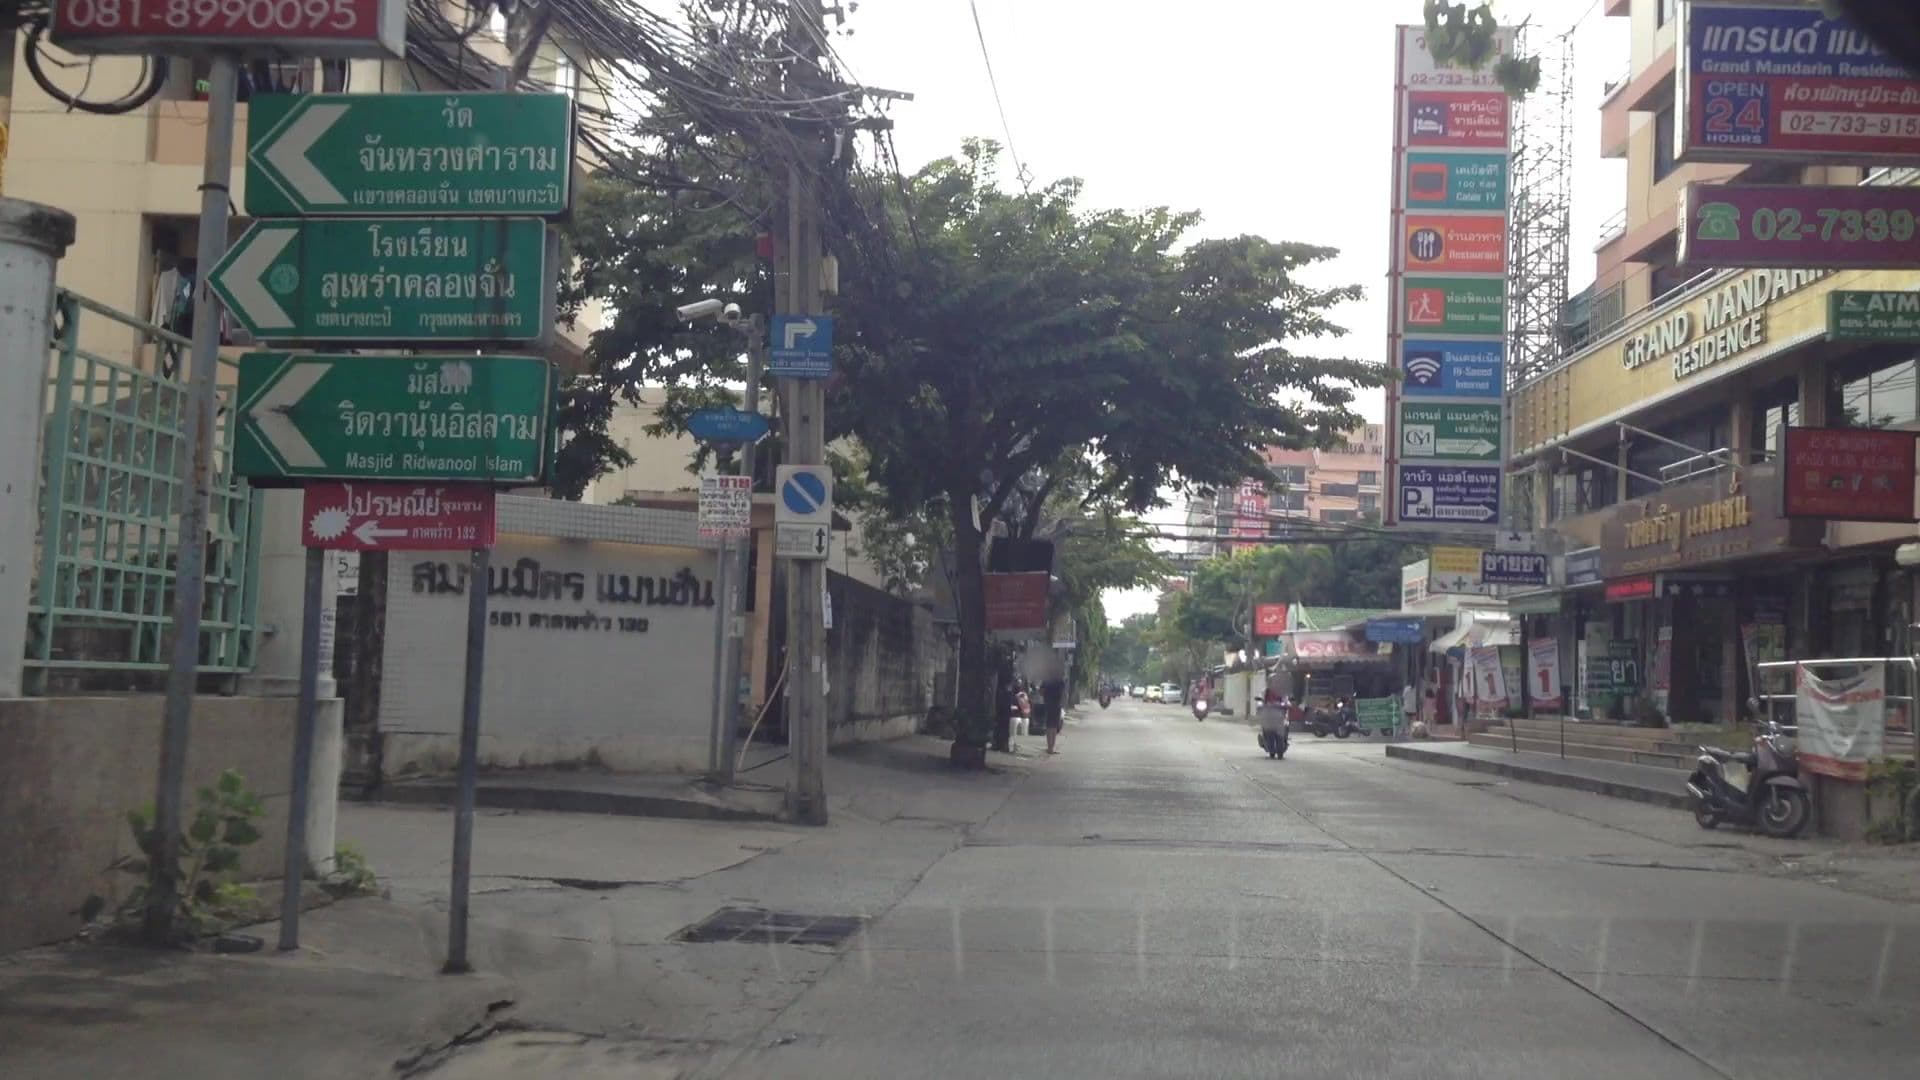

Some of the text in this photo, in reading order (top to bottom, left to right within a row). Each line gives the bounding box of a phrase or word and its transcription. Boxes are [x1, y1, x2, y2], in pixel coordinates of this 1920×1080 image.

[67, 0, 357, 28] 081-8990095
[1703, 20, 1886, 56] แกรนด์ แม
[1702, 58, 1750, 74] Grand
[1755, 60, 1833, 76] Mandarin
[1707, 80, 1764, 98] OPEN
[441, 98, 473, 128] วัด
[1705, 97, 1765, 133] 24
[1790, 115, 1920, 135] 02-733-915
[359, 134, 557, 172] จันทรวงศาราม
[1706, 133, 1762, 145] HOURS
[1752, 207, 1920, 242] 02-7339
[367, 224, 468, 258] โรงเรียน
[1449, 250, 1500, 260] Restaurant
[321, 257, 516, 306] สุเหร่าคลองจั่น
[1866, 293, 1920, 313] ATM
[1622, 309, 1690, 371] GRAND
[1671, 312, 1763, 380] RESIDENCE
[345, 453, 523, 472] Masjid Ridwanool Islam
[343, 483, 444, 517] ไปรษณีย์
[1484, 553, 1545, 573] ขายยา
[411, 557, 715, 607] สมนมิตร แมนชั่น
